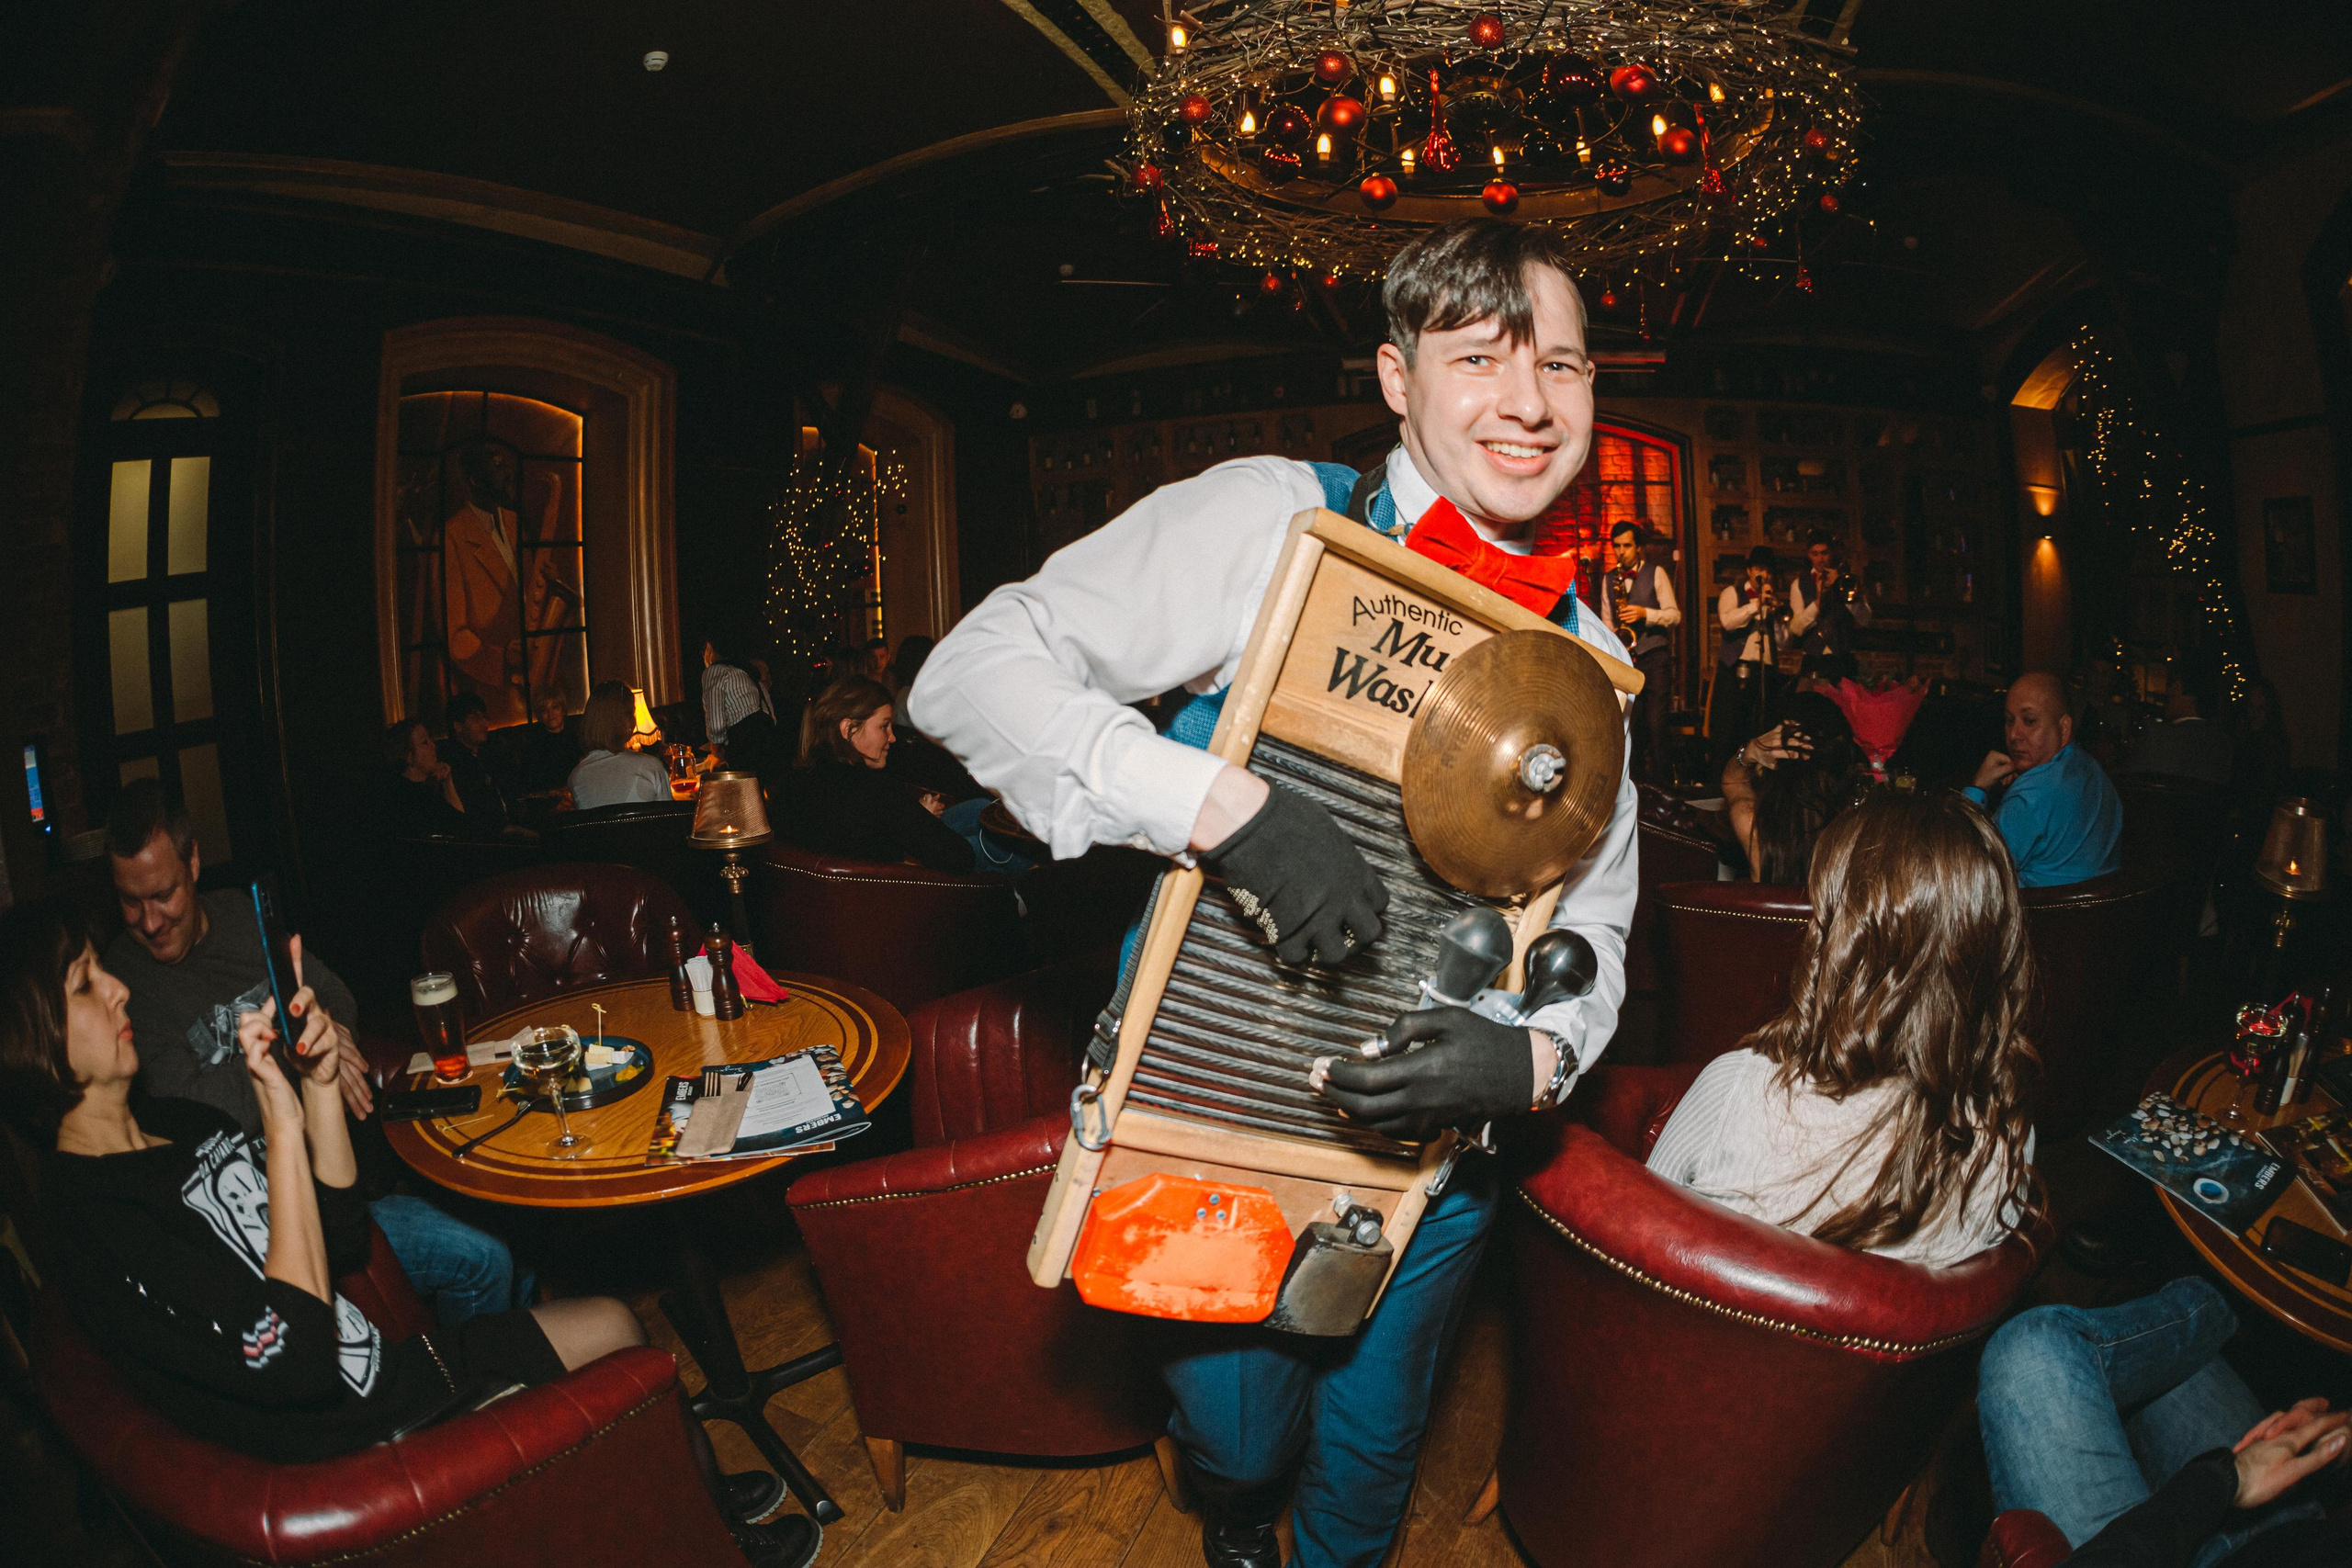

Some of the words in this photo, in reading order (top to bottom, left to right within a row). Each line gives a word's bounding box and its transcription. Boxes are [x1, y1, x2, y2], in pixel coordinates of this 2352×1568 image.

[1352, 594, 1463, 636] Authentic
[1370, 617, 1454, 672] Mu
[795, 1112, 842, 1134] EMBERS
[2254, 1162, 2281, 1190] EMBERS
